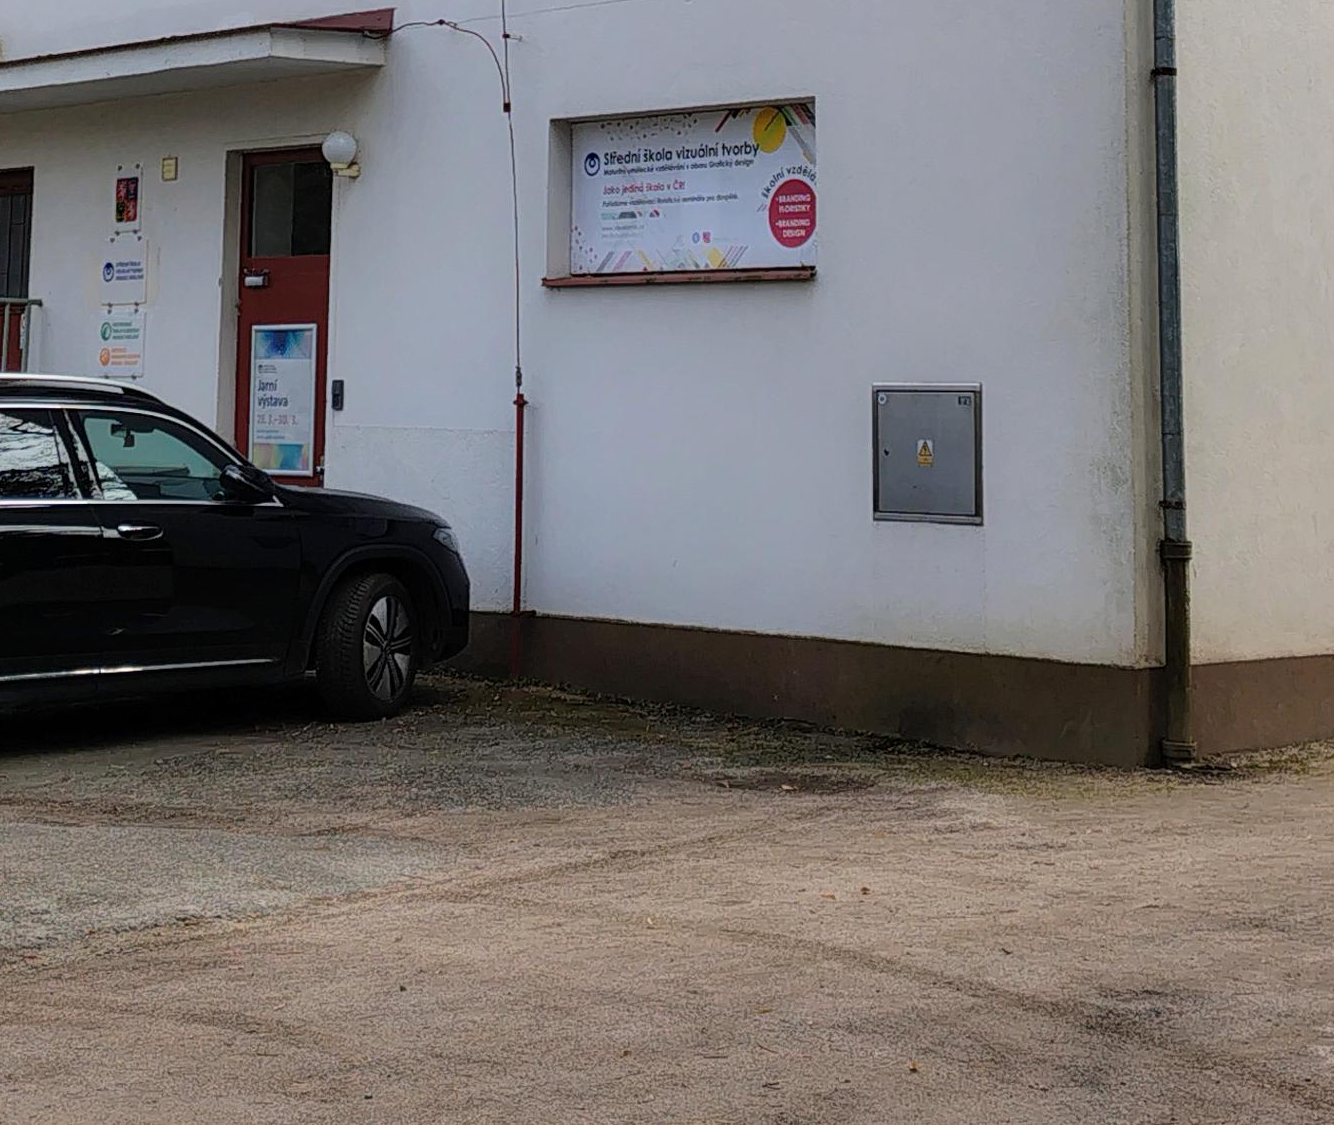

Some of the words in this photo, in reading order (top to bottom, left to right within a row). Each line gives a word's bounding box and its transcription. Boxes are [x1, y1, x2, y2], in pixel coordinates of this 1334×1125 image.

[603, 149, 641, 166] Střední
[643, 148, 673, 163] škola
[676, 141, 718, 160] vizuální
[722, 141, 760, 158] tvorby
[603, 185, 620, 195] Jako
[257, 394, 289, 409] výstava
